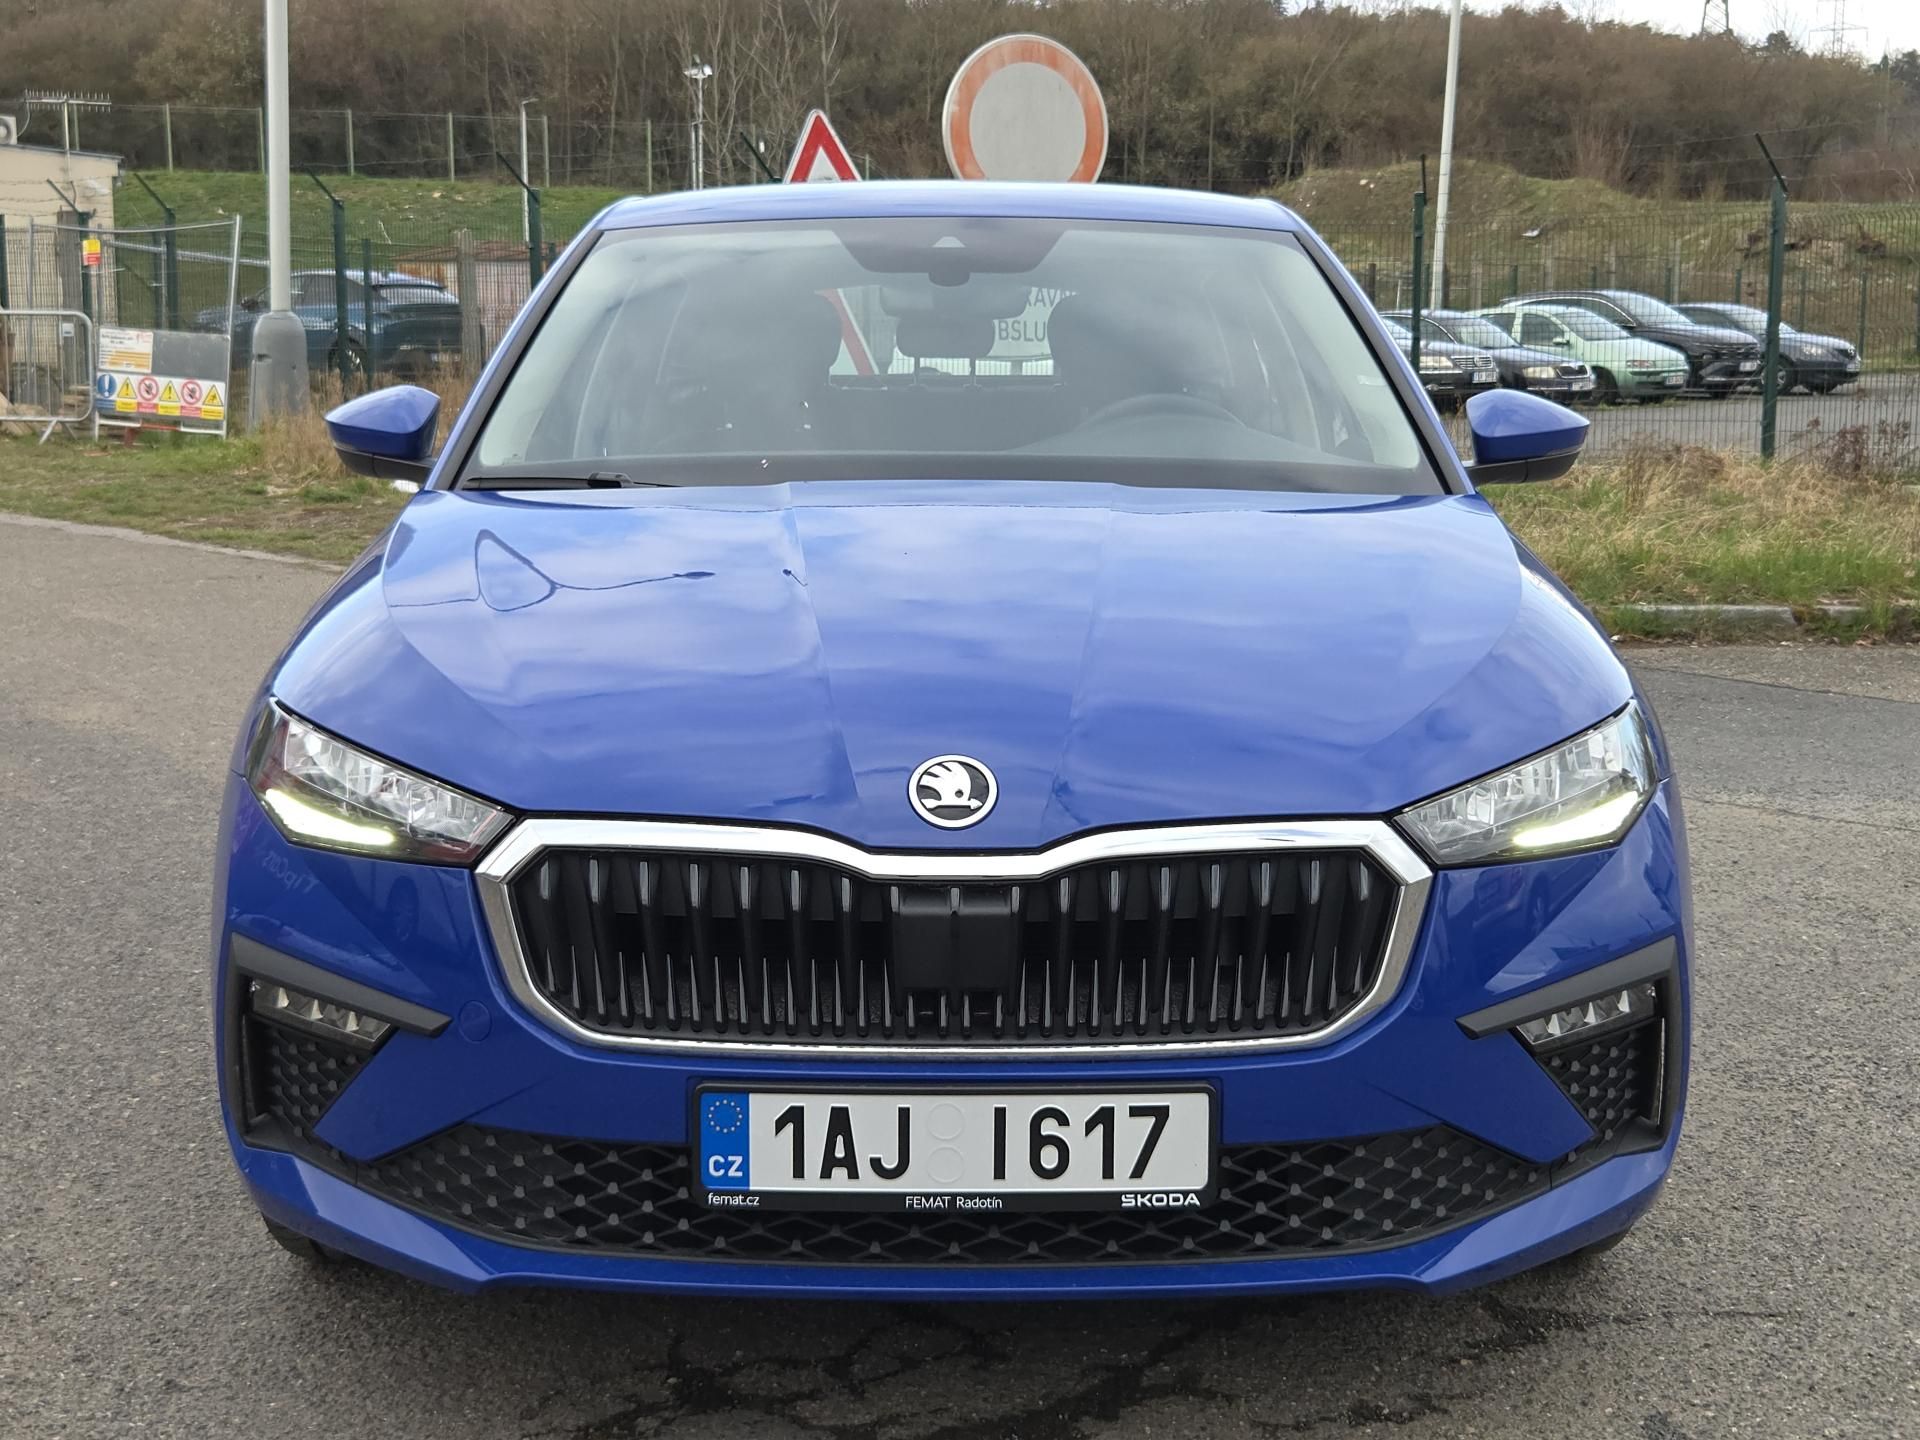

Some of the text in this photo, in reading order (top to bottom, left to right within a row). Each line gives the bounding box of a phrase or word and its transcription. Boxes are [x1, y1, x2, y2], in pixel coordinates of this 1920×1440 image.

[775, 1104, 1170, 1180] 1AJ I617
[708, 1155, 743, 1177] CZ
[707, 1192, 760, 1206] femat.cz
[905, 1195, 1003, 1209] FEMAT Radotín
